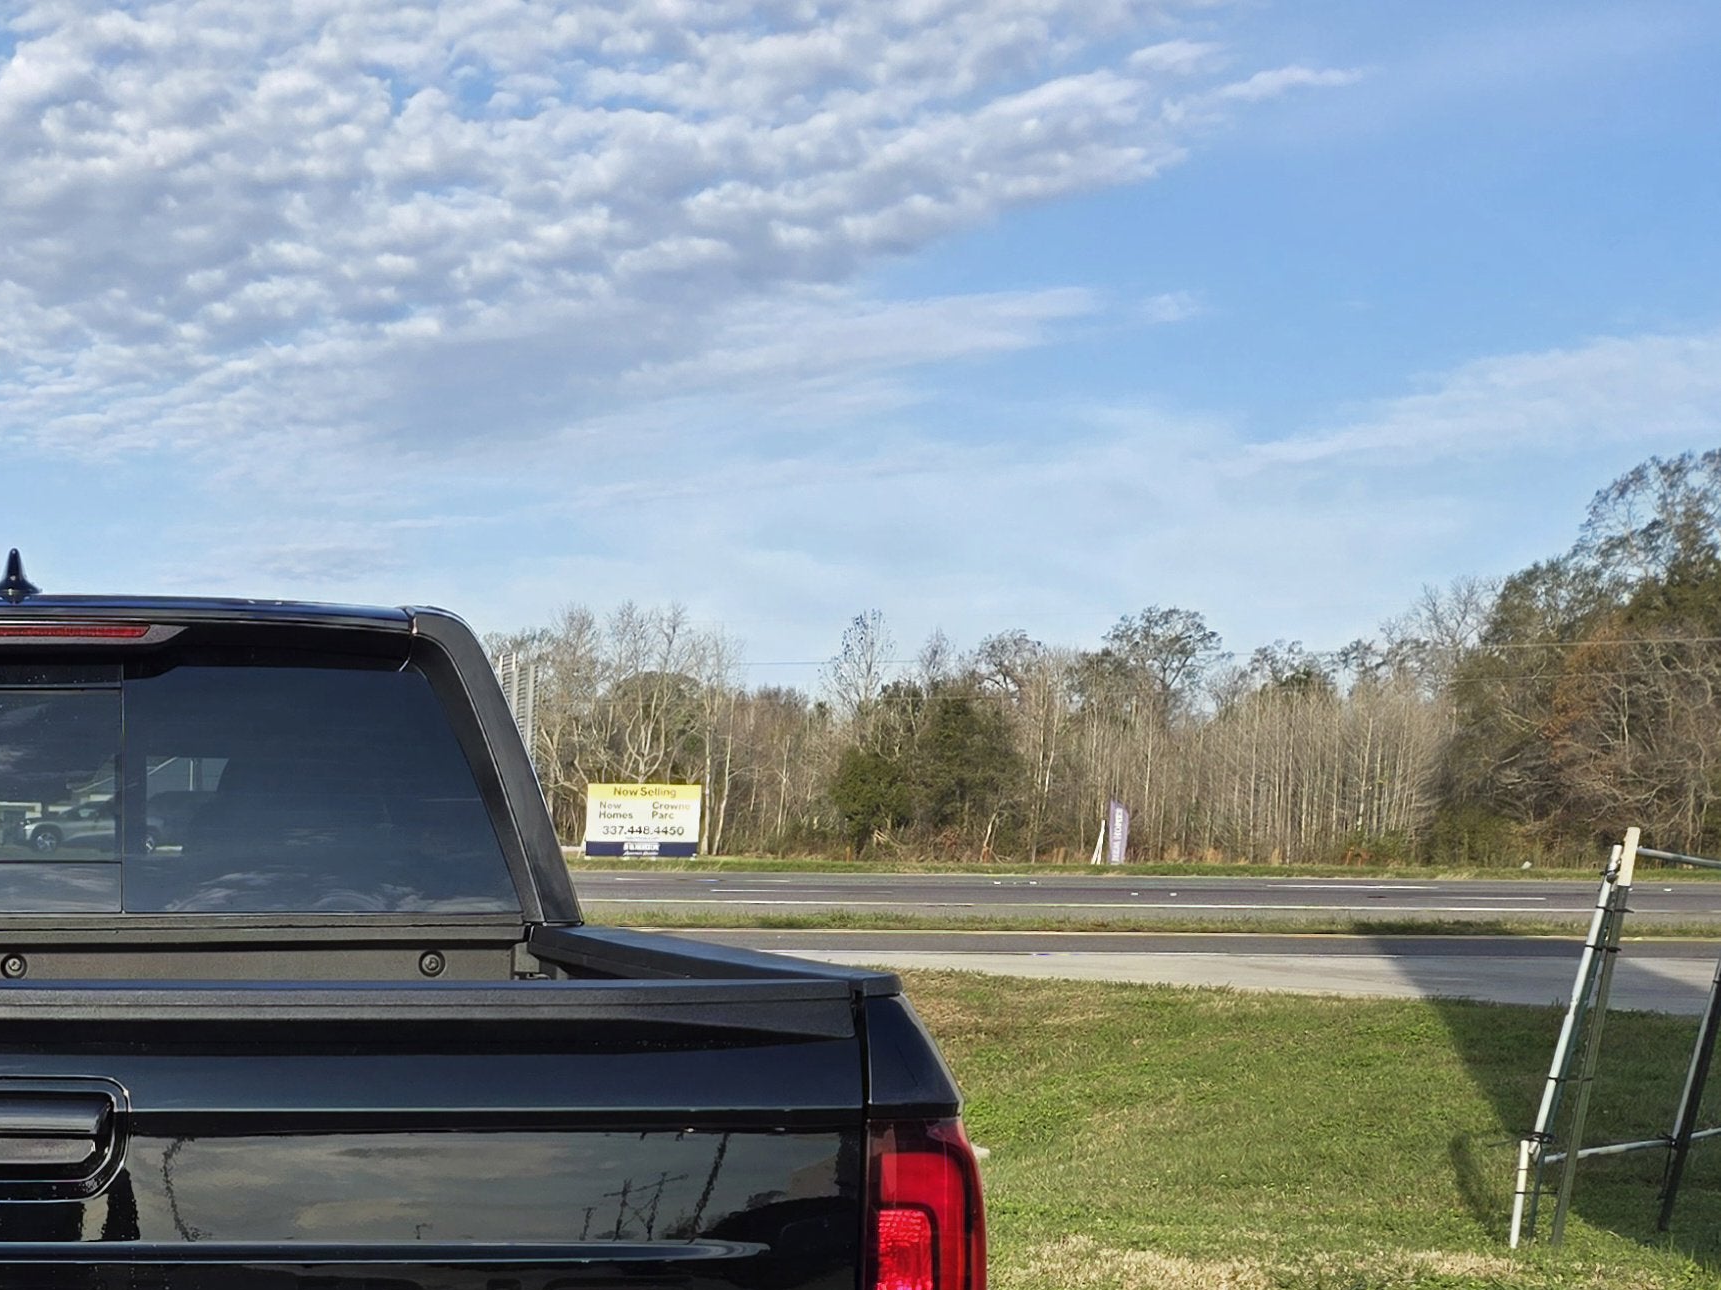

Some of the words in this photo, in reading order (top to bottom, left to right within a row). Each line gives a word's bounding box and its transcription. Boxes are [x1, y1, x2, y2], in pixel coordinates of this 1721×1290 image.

[613, 787, 638, 796] Now
[640, 786, 677, 798] Selling
[599, 811, 633, 819] Homes
[651, 811, 674, 819] Parc
[602, 825, 685, 835] 337.448.4450
